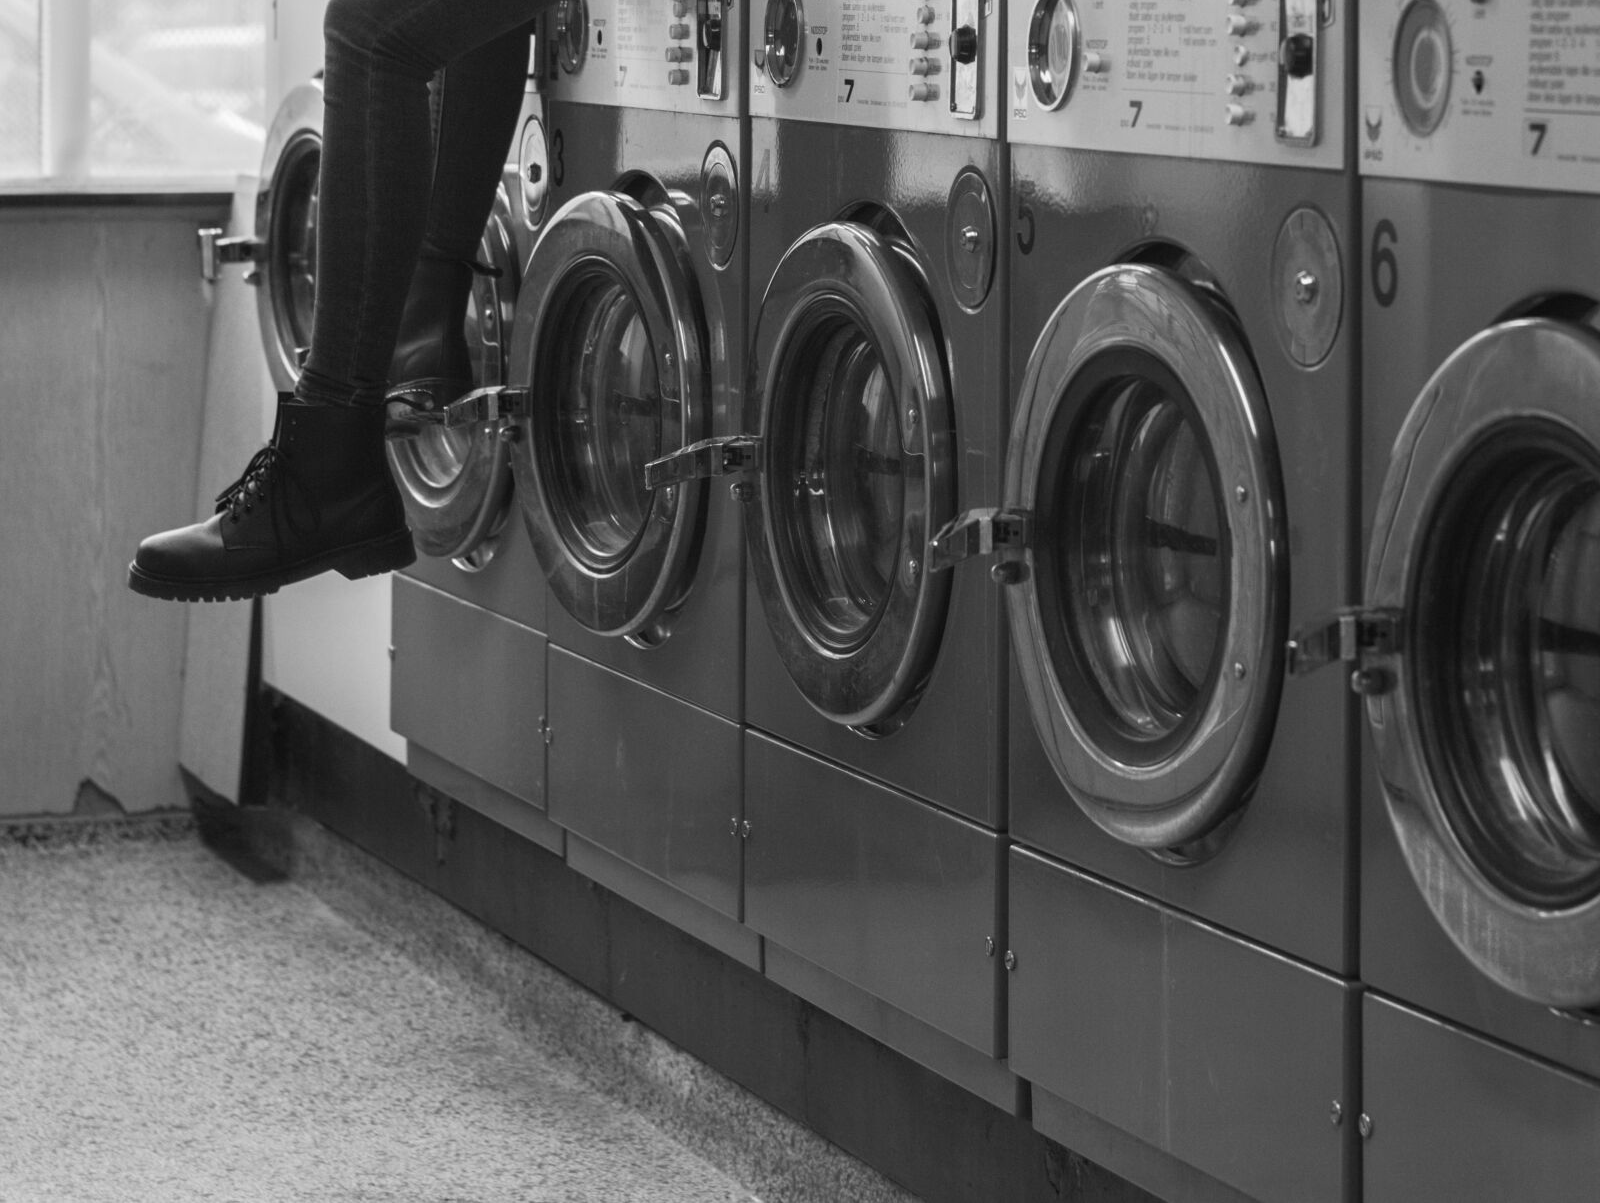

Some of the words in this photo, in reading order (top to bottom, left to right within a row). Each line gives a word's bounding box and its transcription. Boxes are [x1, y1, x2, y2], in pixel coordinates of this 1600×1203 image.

[619, 65, 628, 87] 7
[844, 79, 855, 103] 7
[1128, 100, 1143, 128] 7
[1528, 122, 1548, 157] 7
[552, 128, 565, 187] 3
[1016, 179, 1036, 256] 5
[1370, 217, 1399, 309] 6
